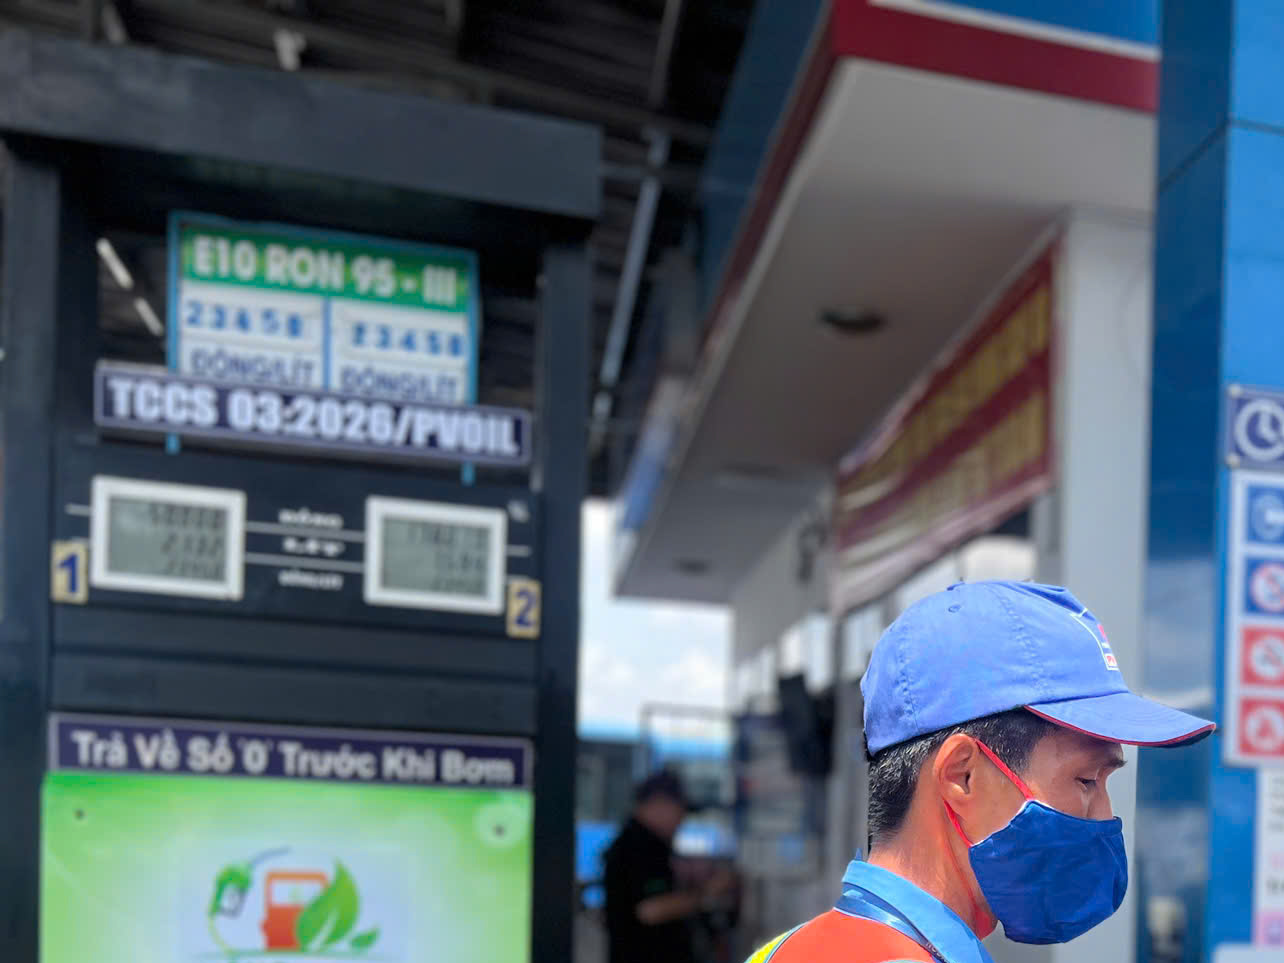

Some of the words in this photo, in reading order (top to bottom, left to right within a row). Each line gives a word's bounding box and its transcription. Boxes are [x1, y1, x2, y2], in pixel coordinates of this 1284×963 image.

[194, 234, 257, 283] E10
[265, 244, 344, 292] RON
[352, 254, 395, 296] 95
[423, 263, 457, 306] III
[108, 377, 217, 426] TCCS
[228, 391, 520, 454] 03:2026/PVOIL
[58, 552, 79, 593] 1
[514, 588, 537, 628] 2
[72, 729, 129, 768] Trả
[187, 731, 234, 772] Số
[279, 741, 376, 779] Trước
[383, 747, 436, 781] Khi
